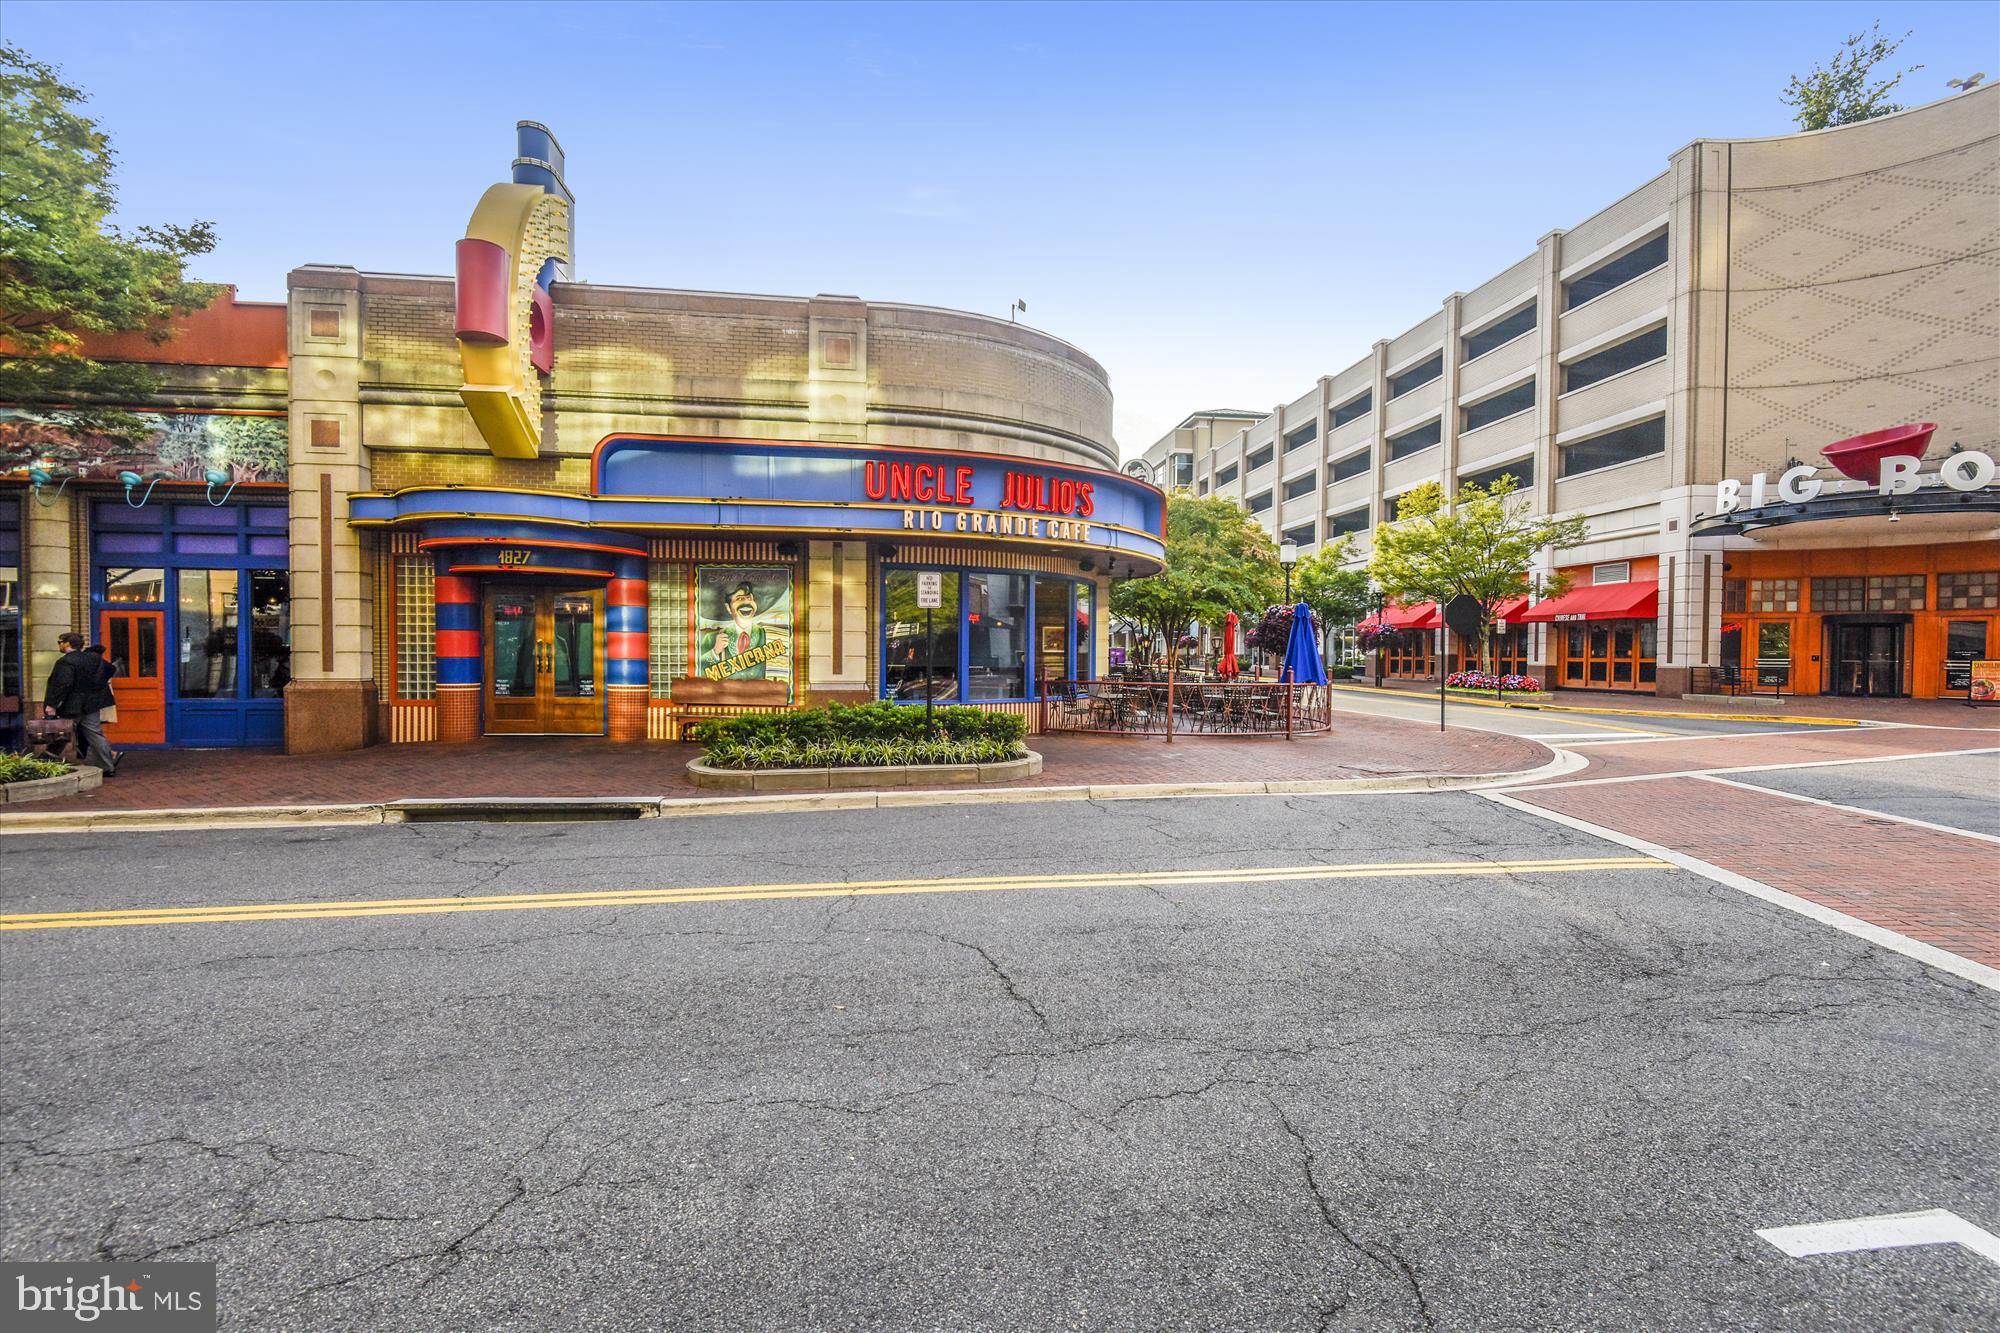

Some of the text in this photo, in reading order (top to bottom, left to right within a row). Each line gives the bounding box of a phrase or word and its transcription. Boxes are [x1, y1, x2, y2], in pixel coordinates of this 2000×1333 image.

[865, 460, 1095, 517] UNCLE JULIO'S
[1716, 465, 1823, 515] BIG
[903, 510, 1091, 542] RIO GRANDE CAFE
[498, 550, 532, 565] 1827
[704, 639, 786, 681] MEXICANA
